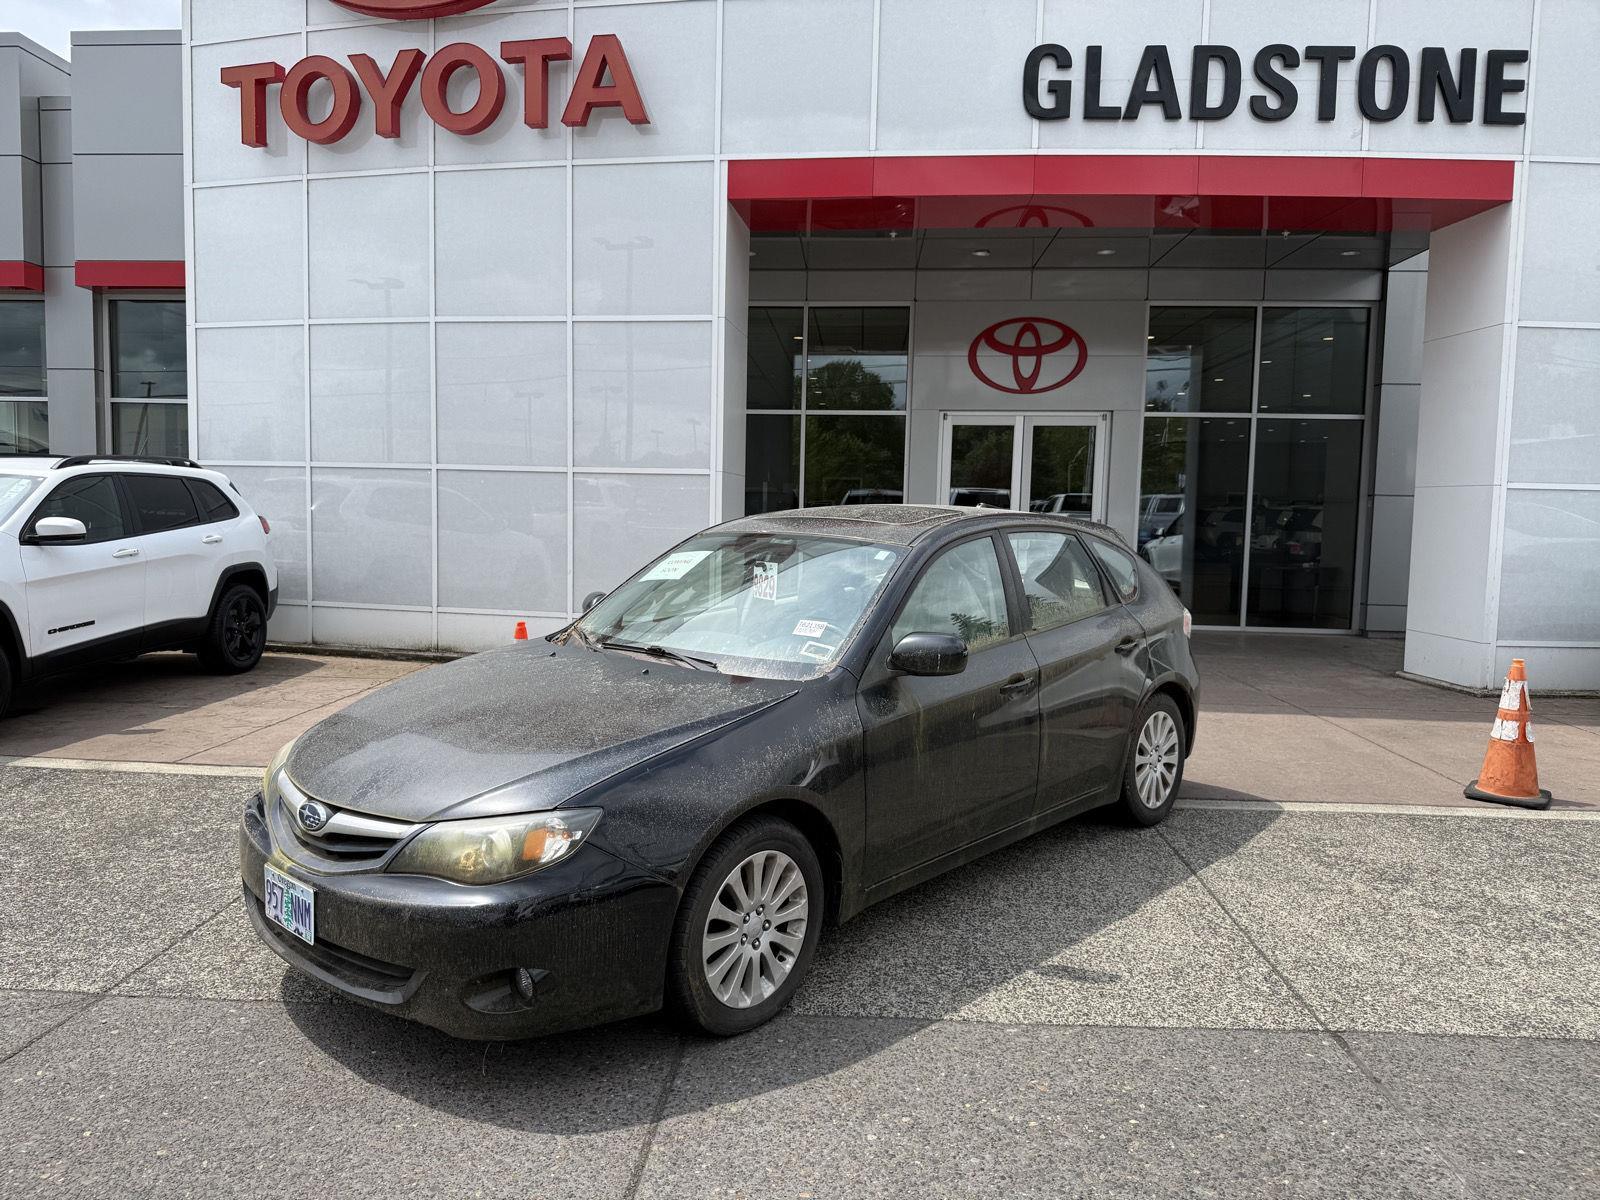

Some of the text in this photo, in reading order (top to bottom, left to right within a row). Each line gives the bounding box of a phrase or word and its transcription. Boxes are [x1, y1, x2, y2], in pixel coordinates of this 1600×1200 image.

[221, 33, 651, 148] TOYOTA
[1023, 43, 1529, 125] GLADSTONE
[266, 879, 311, 930] 957 NNM
